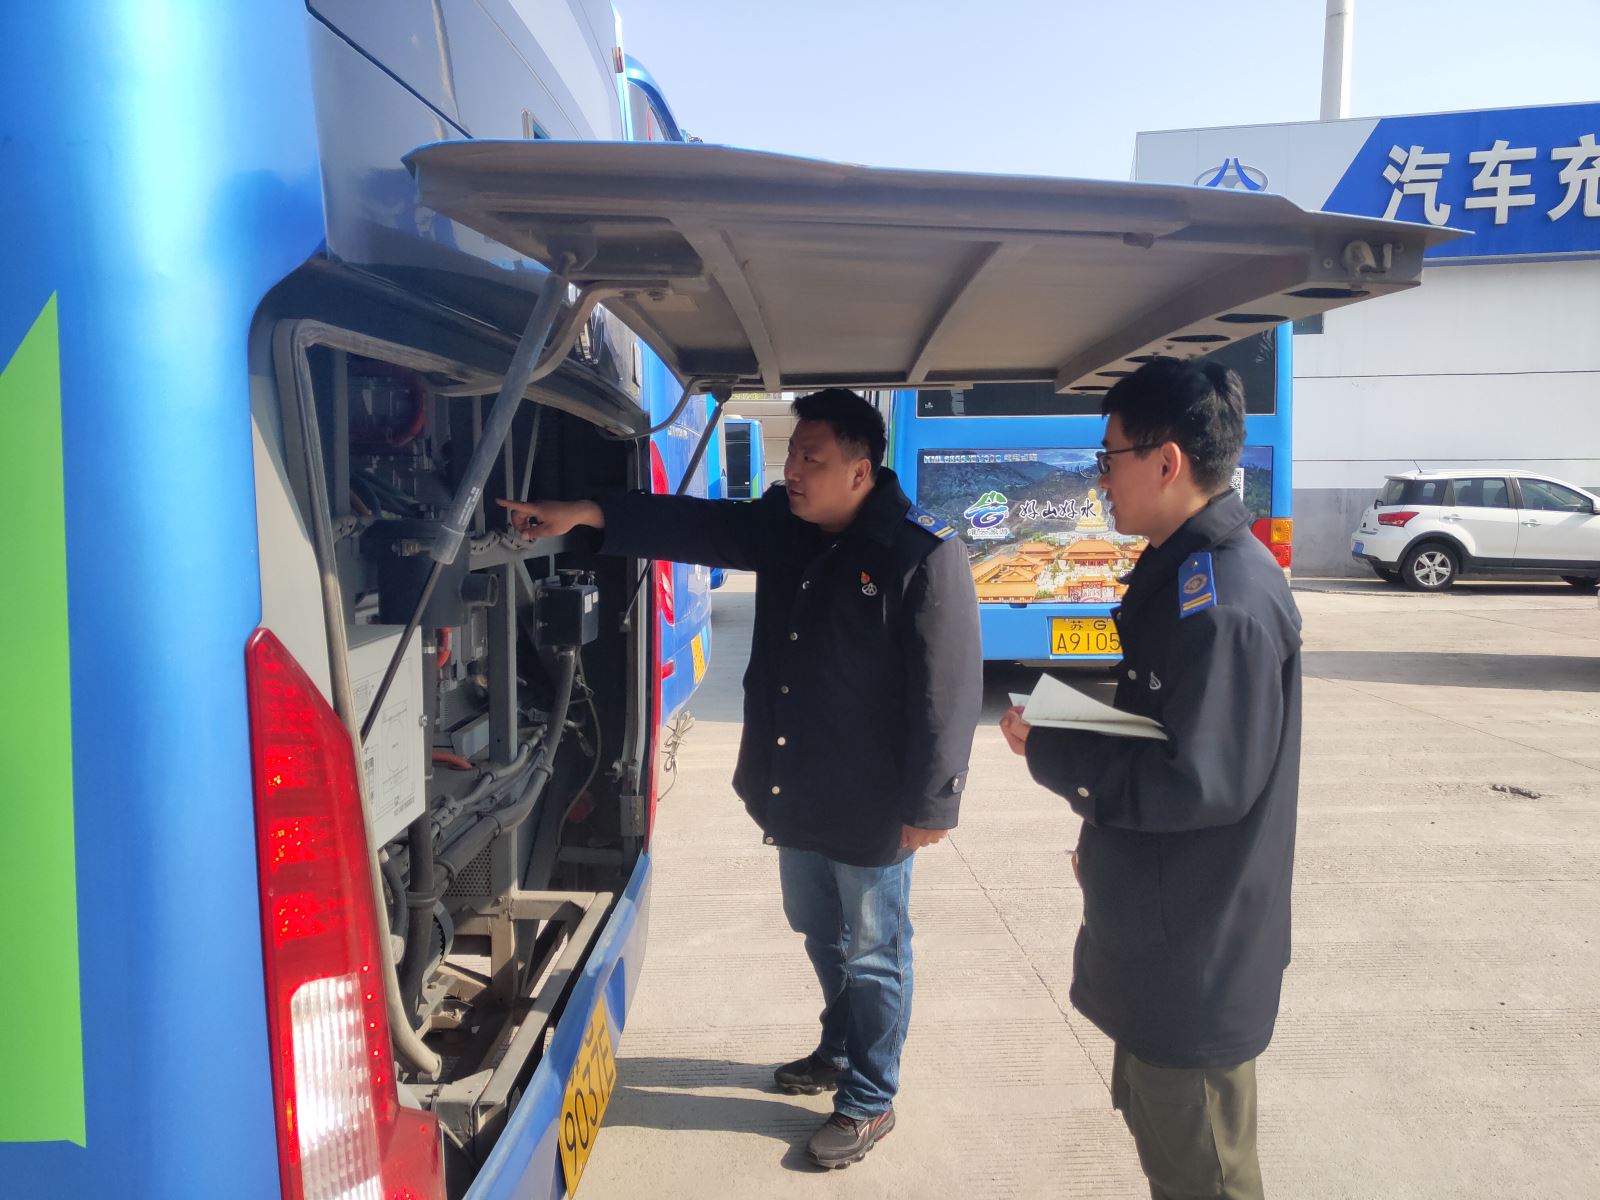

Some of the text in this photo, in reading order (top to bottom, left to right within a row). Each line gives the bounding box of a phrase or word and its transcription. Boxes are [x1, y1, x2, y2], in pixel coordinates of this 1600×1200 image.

[1020, 499, 1097, 520] 好山好水
[1057, 632, 1121, 652] A9105
